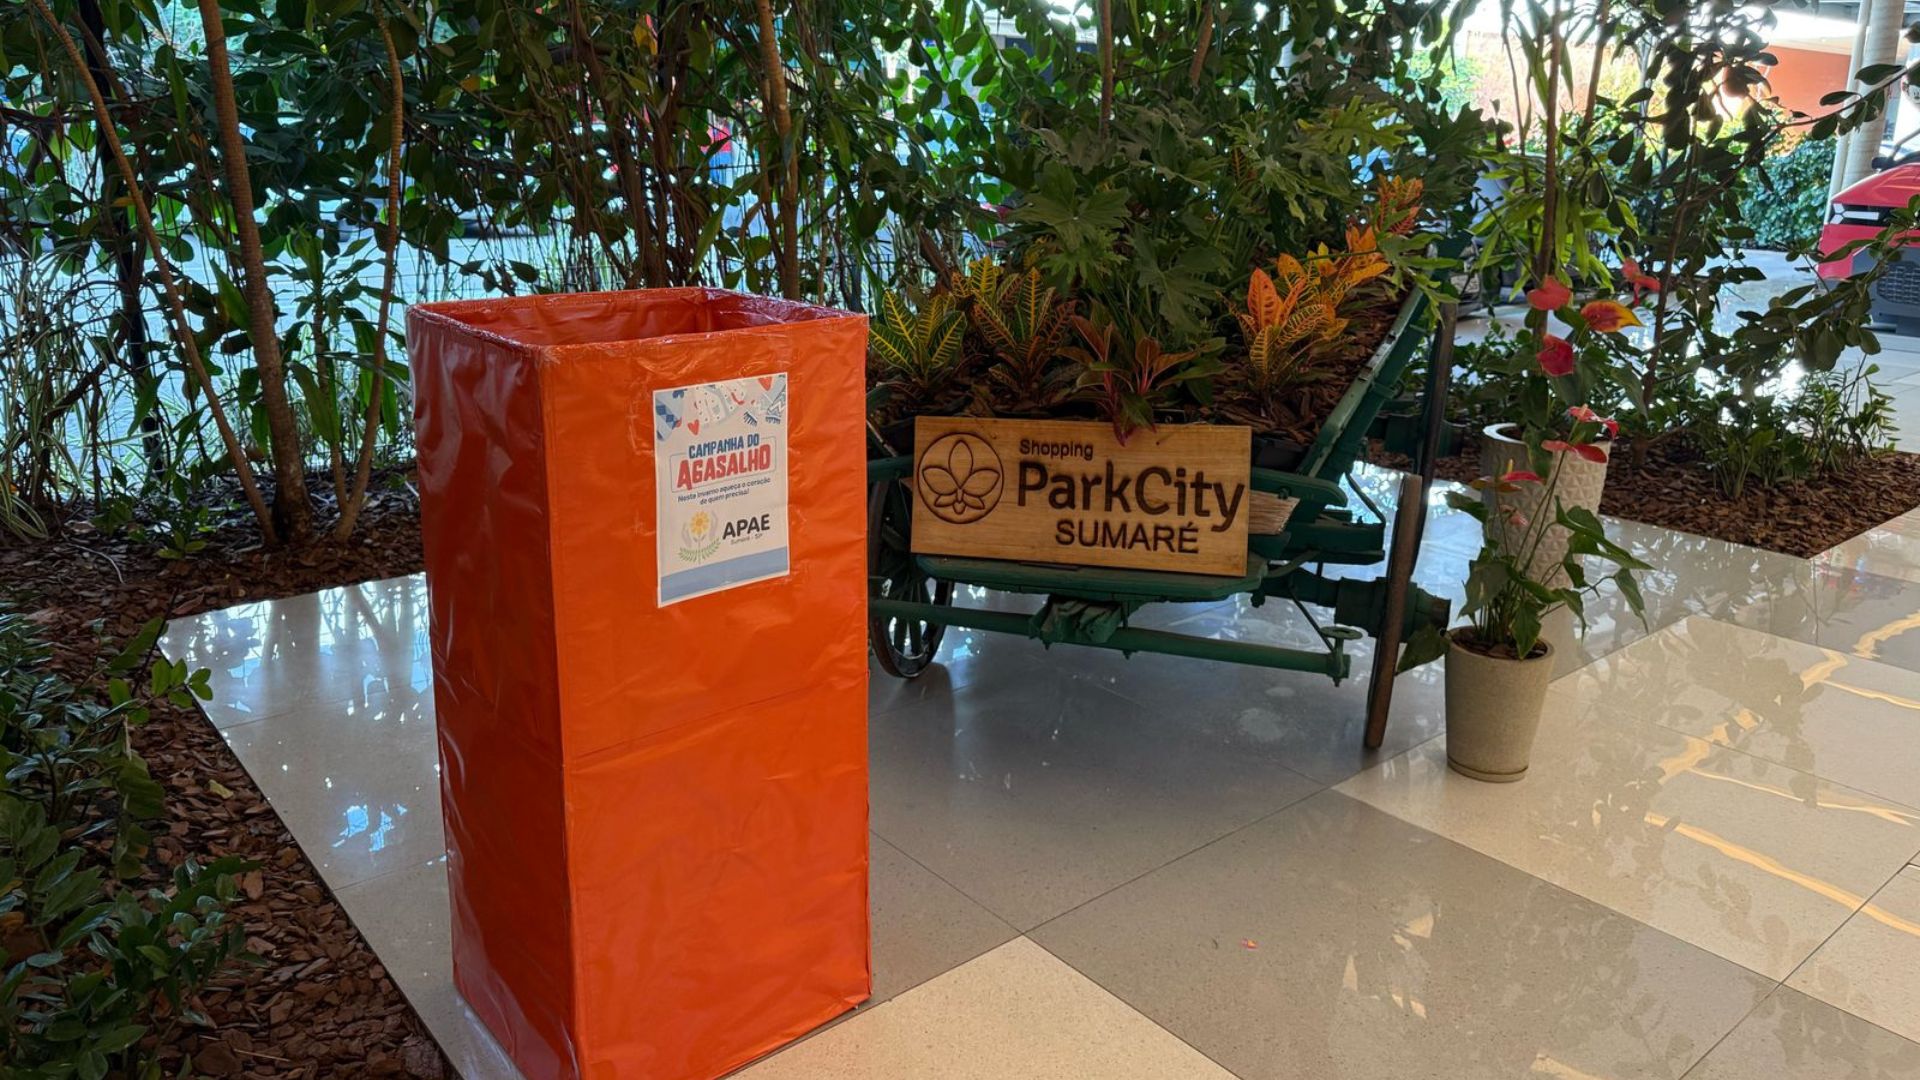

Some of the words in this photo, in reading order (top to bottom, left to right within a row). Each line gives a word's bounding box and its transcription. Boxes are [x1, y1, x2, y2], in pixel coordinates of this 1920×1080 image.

[689, 436, 744, 459] CAMPANHA
[747, 433, 760, 448] DO
[1019, 439, 1093, 460] Shopping
[677, 444, 771, 490] AGASALHO
[678, 493, 697, 502] Neste
[747, 476, 771, 487] coração
[708, 494, 725, 504] quem
[1017, 461, 1245, 532] ParkCity
[722, 513, 770, 540] APAE
[1055, 519, 1199, 554] SUMARÉ
